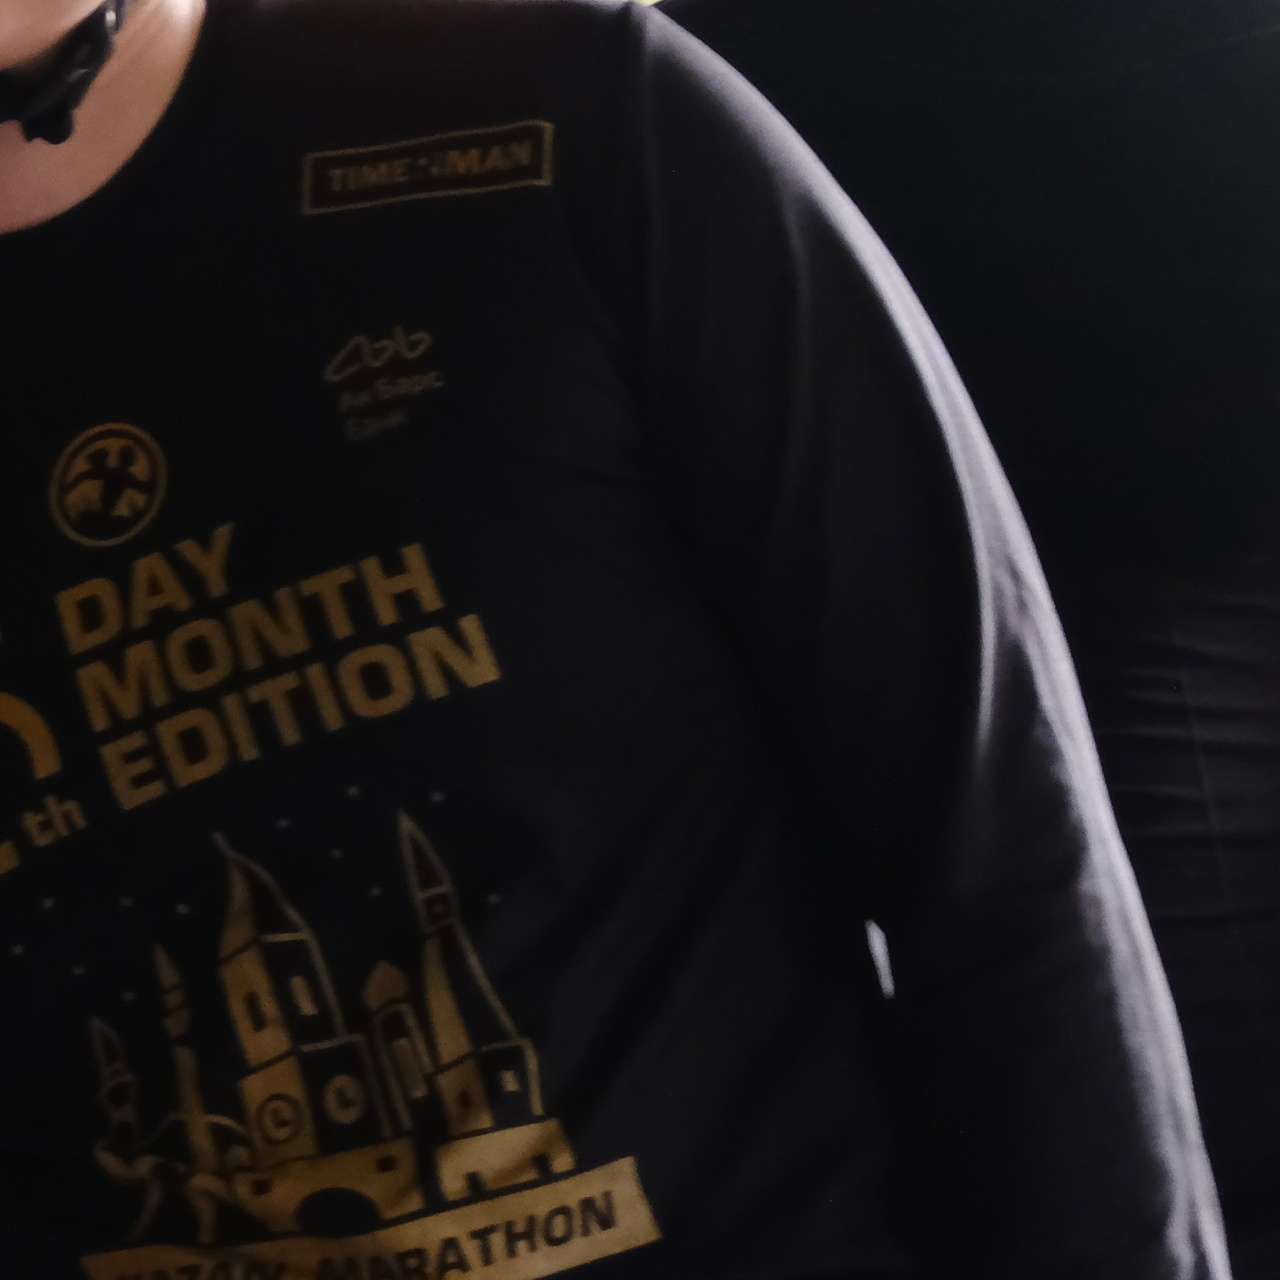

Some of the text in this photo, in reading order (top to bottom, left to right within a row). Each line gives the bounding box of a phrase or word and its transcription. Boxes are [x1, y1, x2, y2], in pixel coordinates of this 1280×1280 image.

[54, 521, 236, 656] DAY
[74, 542, 446, 733] MONTH
[98, 613, 503, 812] EDITION
[314, 1190, 619, 1280] MARATHON
